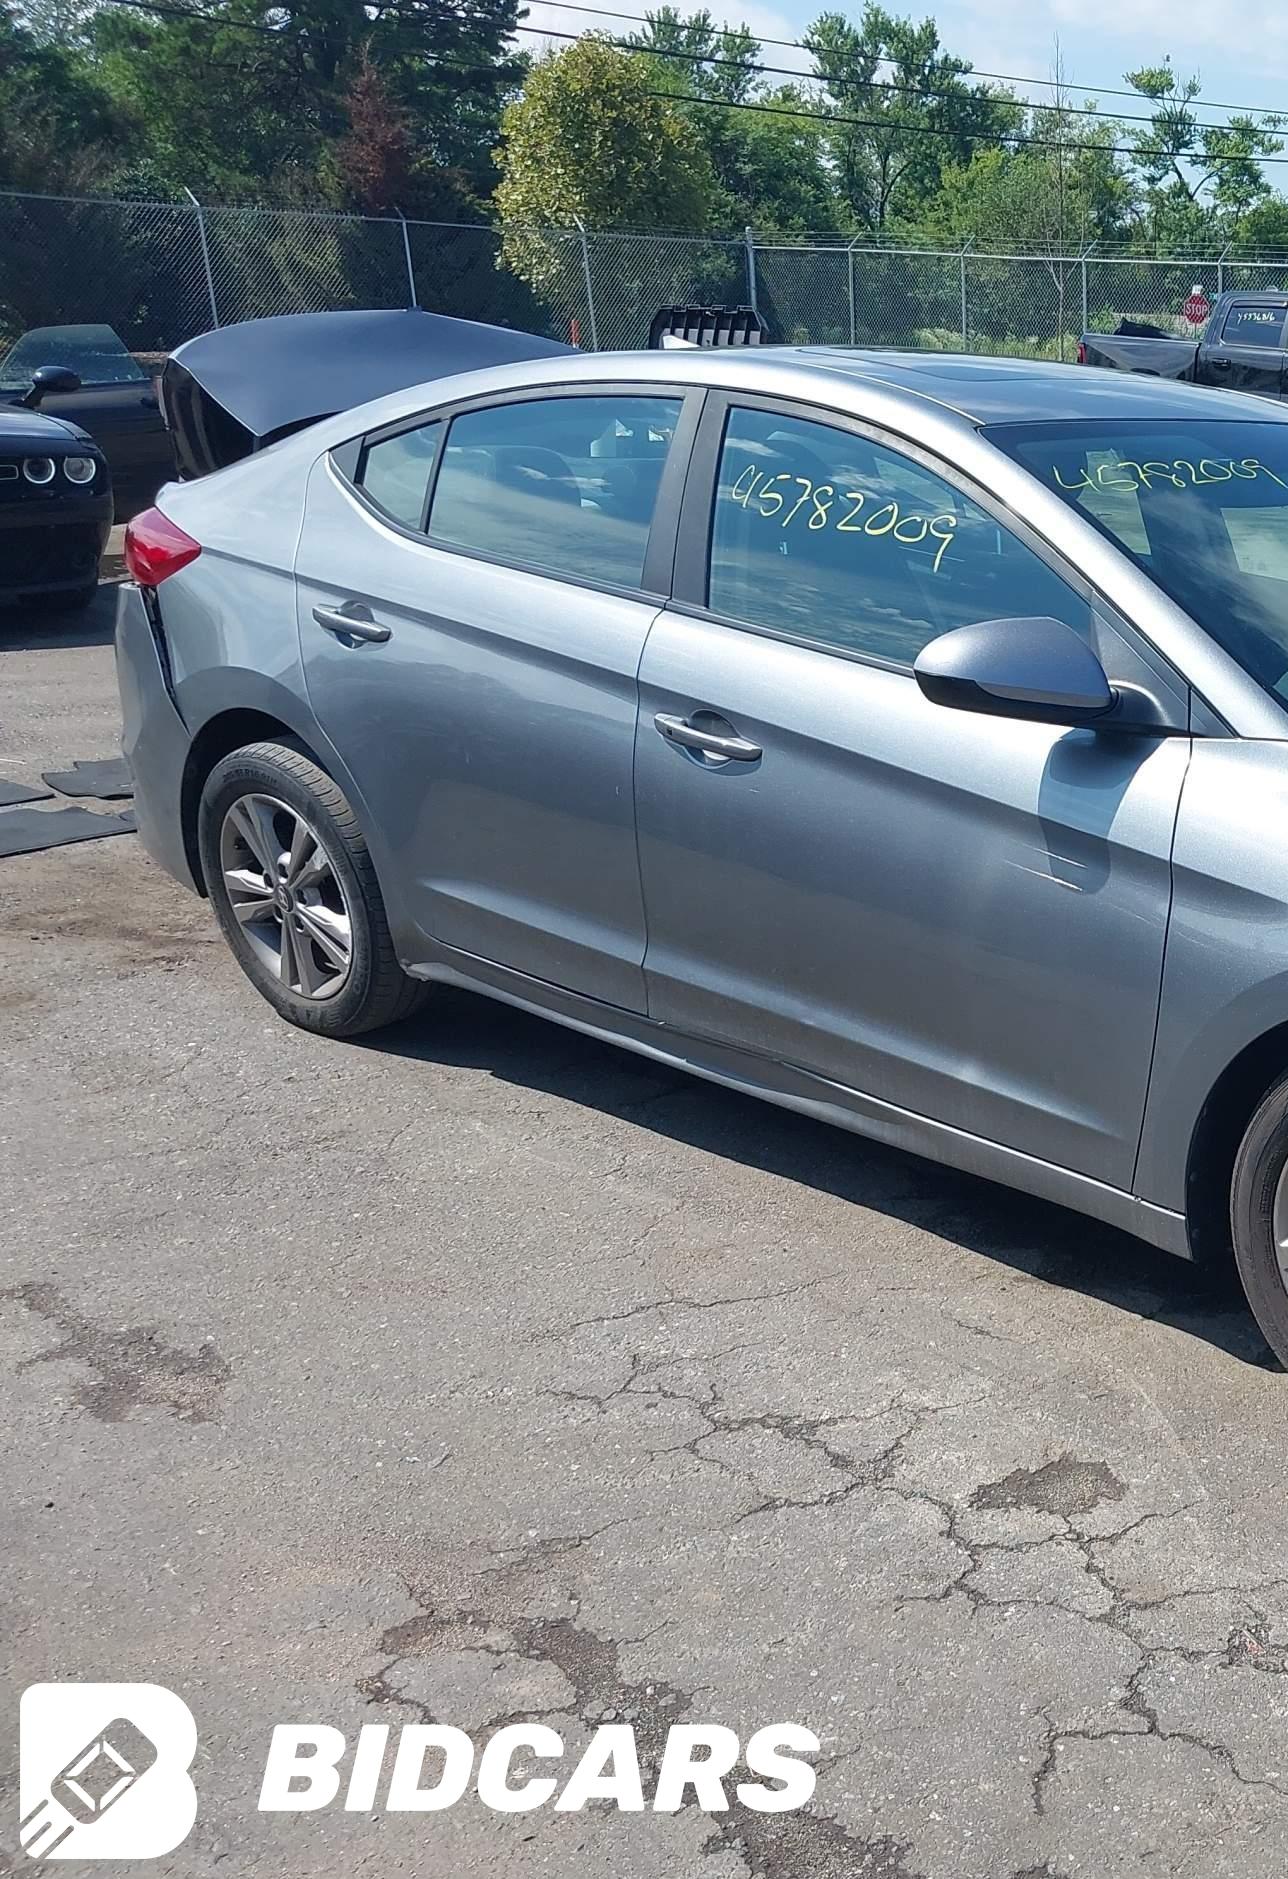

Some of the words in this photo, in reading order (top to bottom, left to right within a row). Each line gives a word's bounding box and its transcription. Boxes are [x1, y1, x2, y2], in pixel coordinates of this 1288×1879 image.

[1185, 303, 1208, 317] STOP
[1053, 458, 1288, 493] 45782009
[732, 464, 957, 574] 45782009
